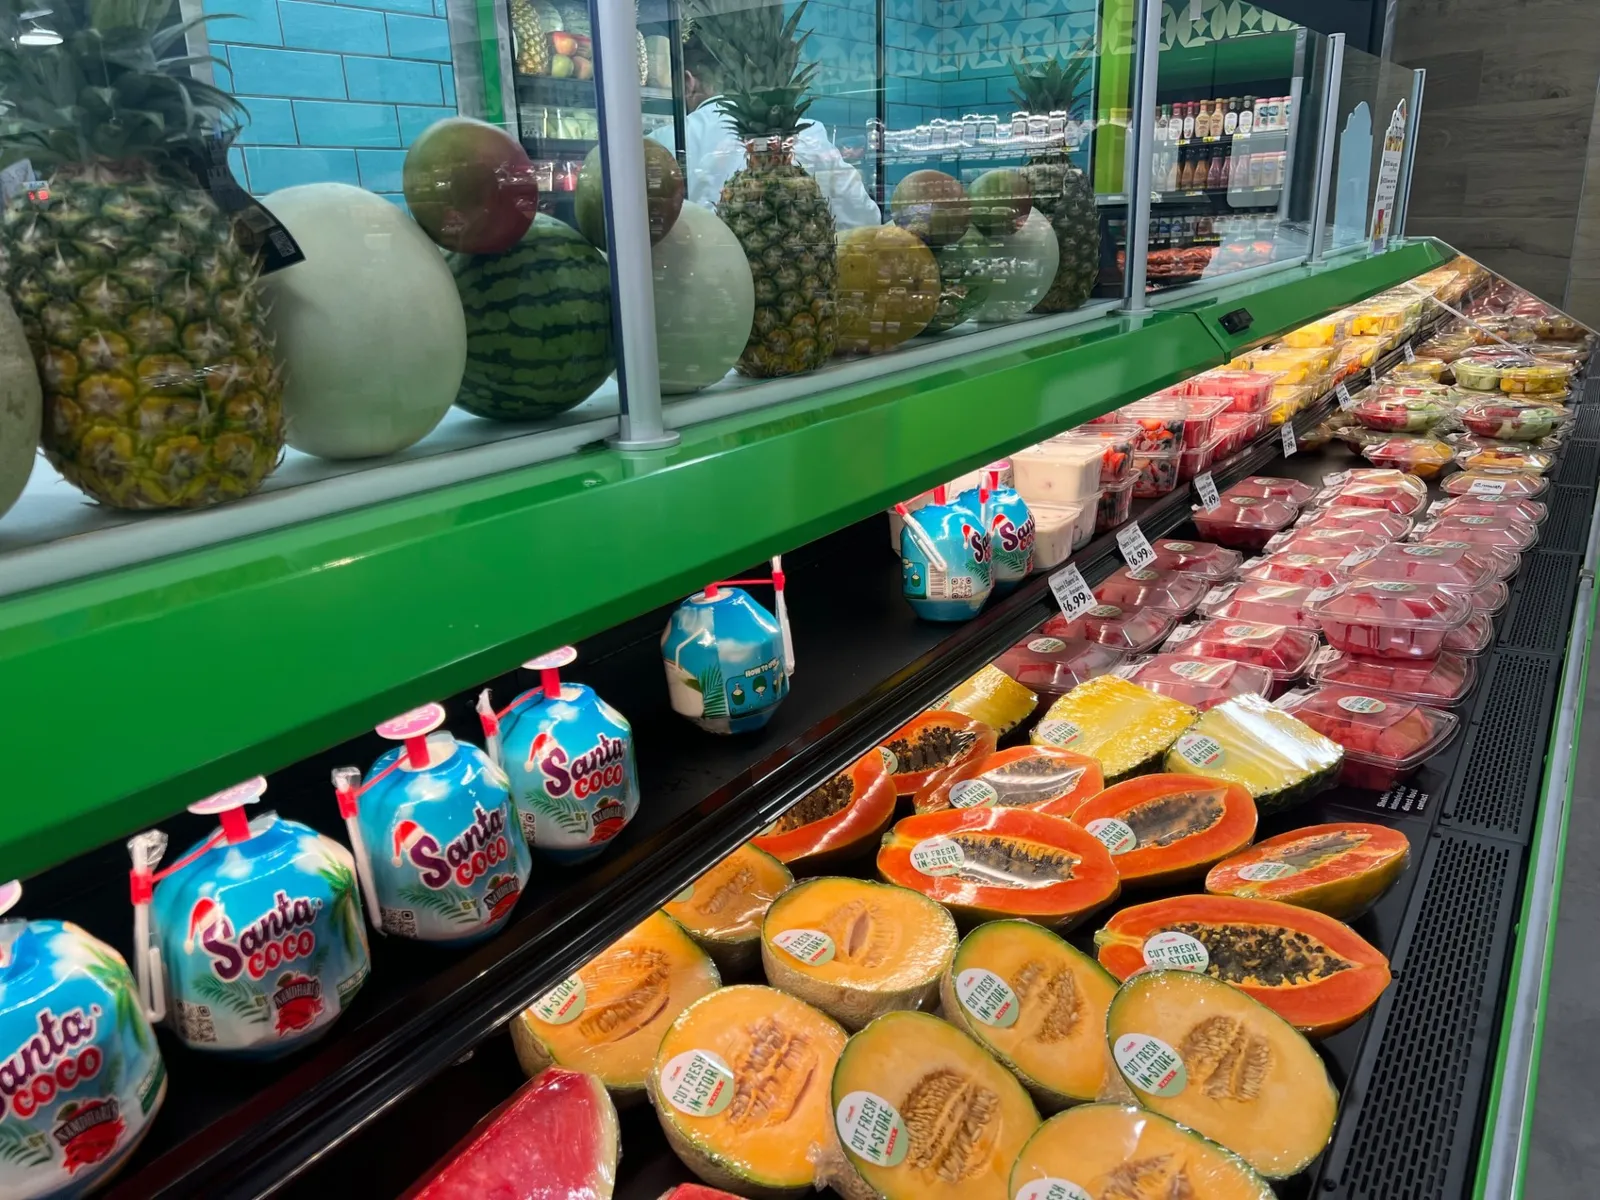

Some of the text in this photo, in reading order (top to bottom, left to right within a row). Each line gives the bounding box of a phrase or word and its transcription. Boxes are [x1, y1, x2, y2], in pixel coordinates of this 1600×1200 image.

[1128, 548, 1149, 566] $6.99
[1062, 592, 1086, 612] $6.99
[1190, 743, 1219, 765] IN-STORE
[1191, 738, 1210, 752] FRESH
[541, 734, 624, 797] Santa
[573, 764, 623, 798] coco
[952, 782, 984, 804] CUT FRESH
[1099, 821, 1119, 838] FRESH
[1104, 827, 1129, 849] -STORE
[409, 808, 504, 888] Santa
[455, 836, 507, 886] coco
[914, 851, 929, 860] CUT
[930, 845, 957, 857] FRESH
[917, 853, 961, 868] IN-STORE
[202, 892, 318, 980] Santa
[790, 932, 814, 949] FRESH
[1147, 943, 1198, 959] CUT FRESH
[248, 931, 315, 979] coco
[539, 980, 578, 1019] IN-STORE
[965, 992, 981, 1009] CUT
[974, 974, 996, 997] FRESH
[977, 984, 1009, 1021] IN-STORE
[1123, 1057, 1141, 1076] CUT
[1135, 1040, 1160, 1064] FRESH
[1136, 1050, 1176, 1089] IN-STORE
[12, 1047, 102, 1117] coco
[672, 1084, 691, 1104] CUT
[683, 1054, 706, 1086] FRESH
[1160, 1072, 1175, 1088] DAILY
[851, 1096, 877, 1151] CUT FRESH
[866, 1105, 893, 1161] IN-STORE
